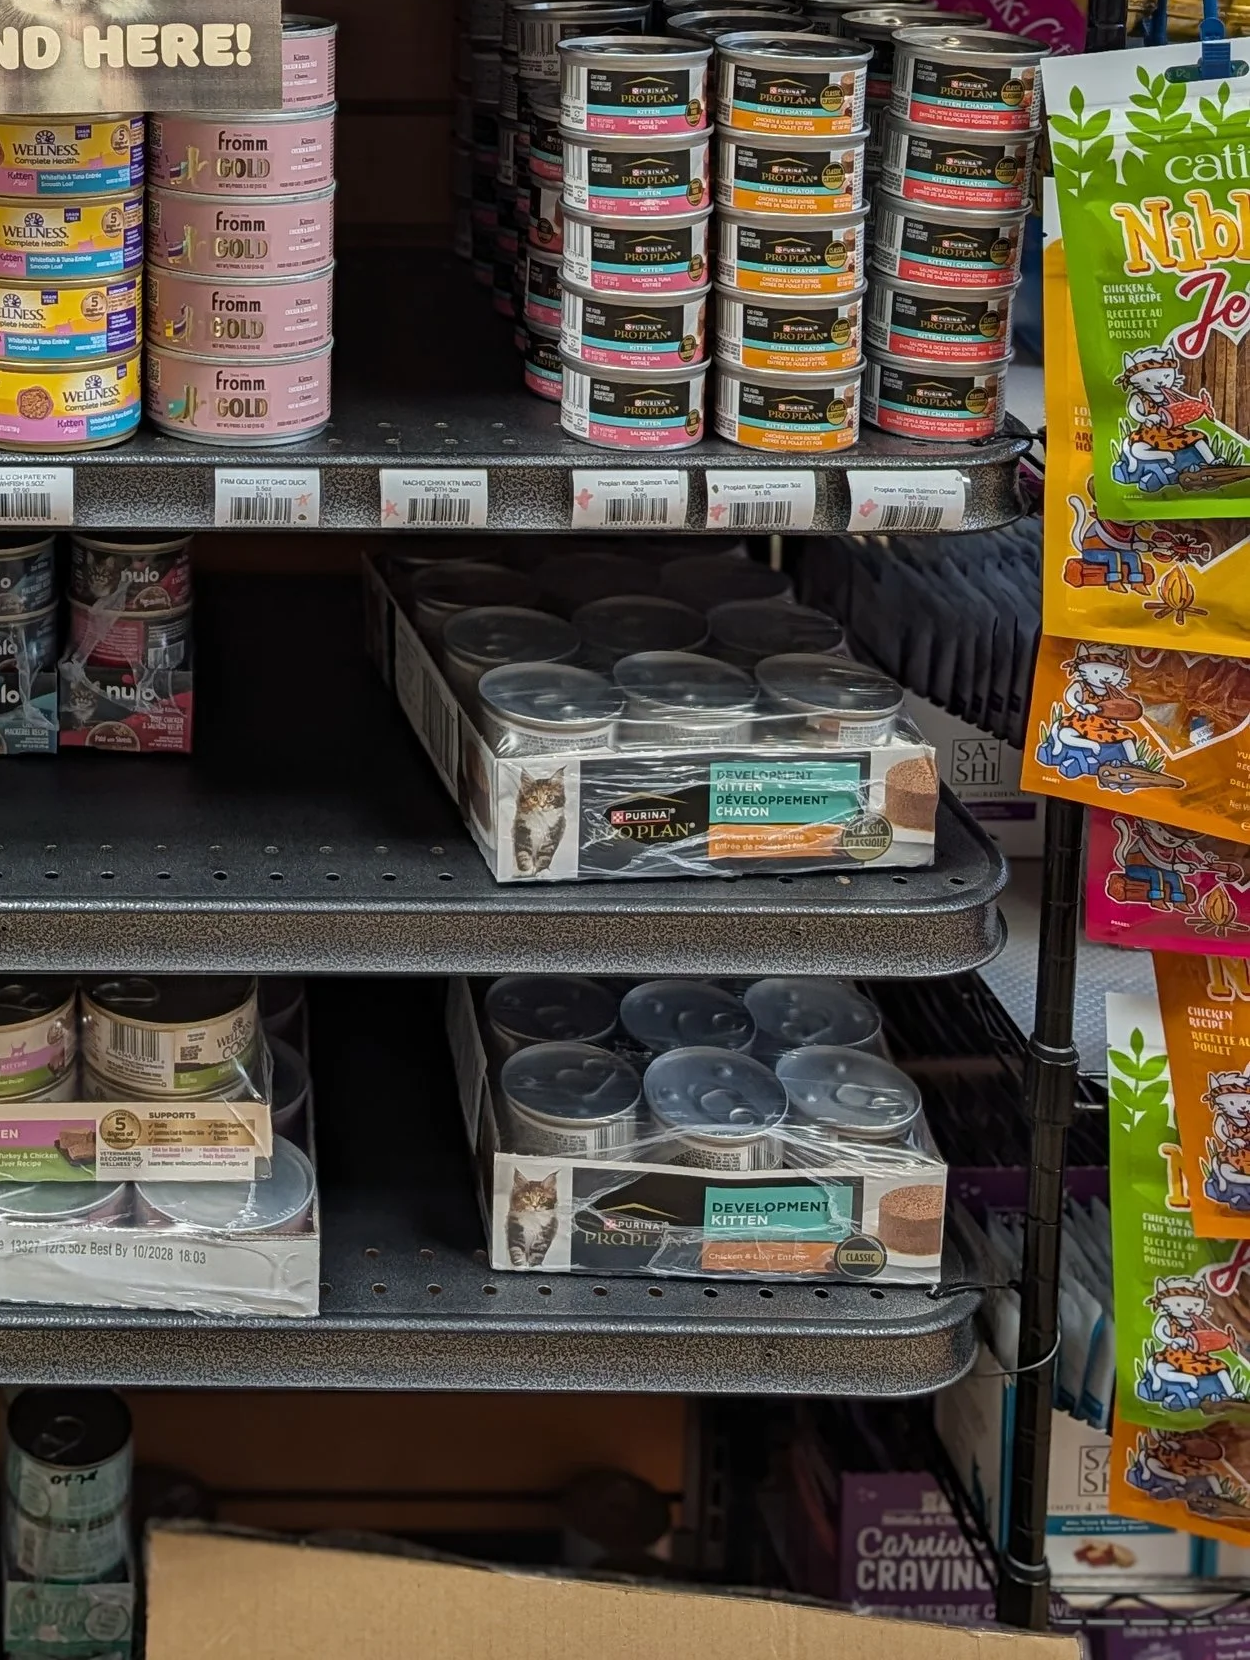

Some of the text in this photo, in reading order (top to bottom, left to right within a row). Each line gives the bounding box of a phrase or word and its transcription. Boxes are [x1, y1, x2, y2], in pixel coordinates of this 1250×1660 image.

[82, 24, 251, 69] HERE!
[621, 94, 674, 104] PRO PLAN
[218, 131, 268, 151] fromm
[216, 157, 271, 179] GOLD
[1103, 284, 1155, 294] CHICKEN &
[1104, 293, 1162, 304] FISH RECIPE
[1107, 309, 1163, 319] RECETTE AU
[1108, 320, 1158, 329] POULET ET
[1109, 330, 1151, 339] POISSON
[957, 742, 996, 761] SA-
[955, 763, 995, 782] SHI
[716, 793, 828, 805] DÉVELOPPEMENT
[716, 806, 770, 817] CHATON
[30, 1152, 58, 1160] Chicken
[16, 1160, 41, 1169] Recipe
[712, 1201, 829, 1213] DEVELOPMENT
[711, 1215, 768, 1226] KITTEN
[90, 1242, 113, 1256] Best
[115, 1243, 128, 1258] By
[133, 1245, 174, 1261] 10/2028
[178, 1249, 207, 1264] 18:03
[846, 1252, 875, 1263] CLASSIC
